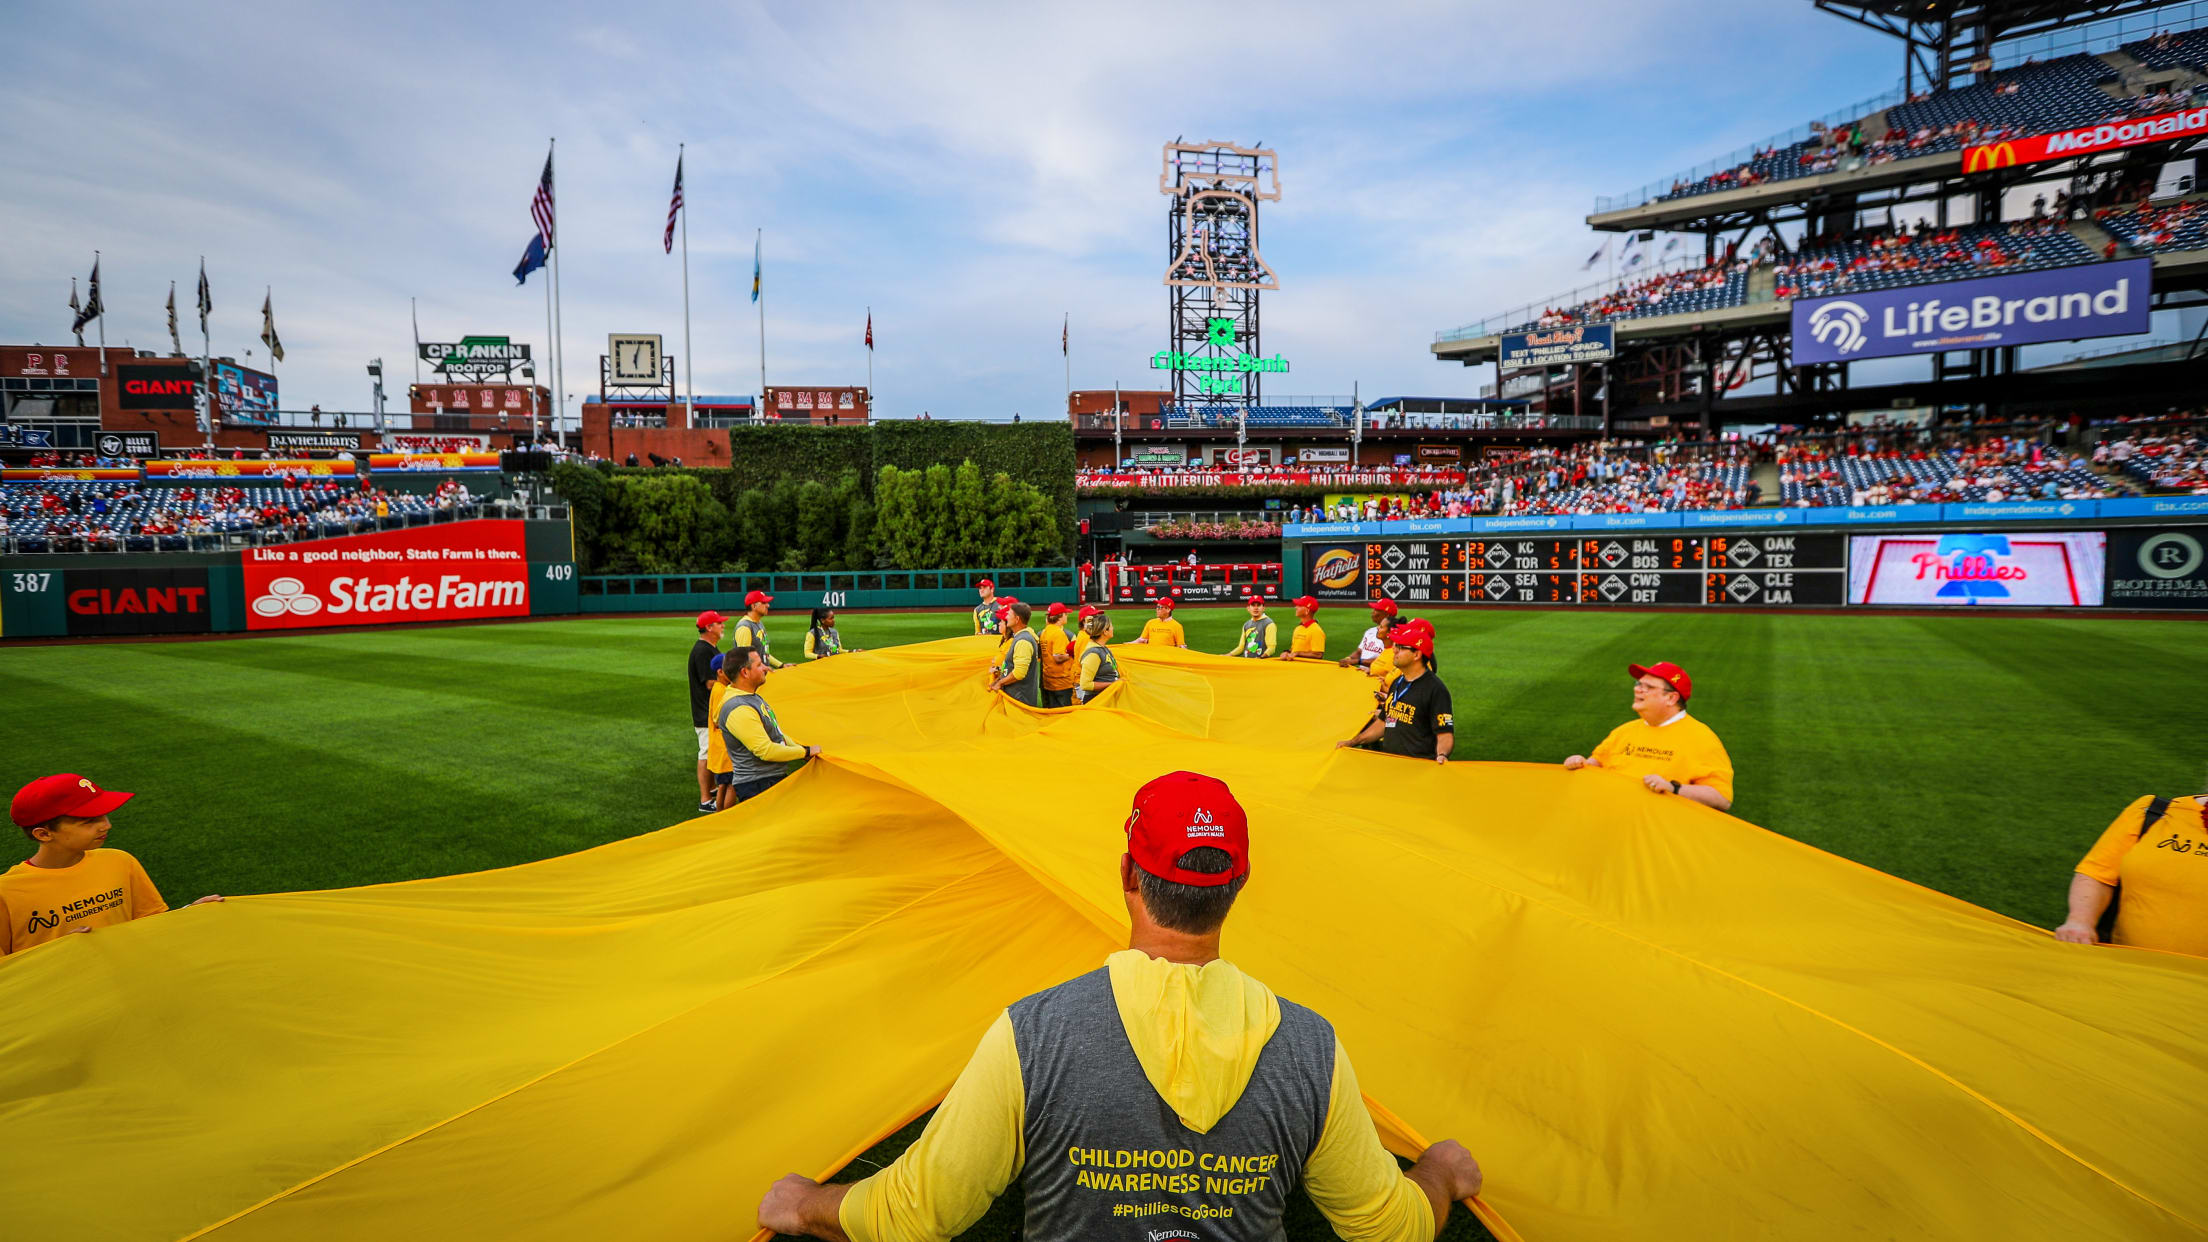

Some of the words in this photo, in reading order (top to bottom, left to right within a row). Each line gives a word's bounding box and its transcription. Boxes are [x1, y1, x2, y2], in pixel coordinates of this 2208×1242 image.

[1884, 278, 2128, 338] LifeBrand
[1553, 327, 1584, 344] Help?
[427, 344, 453, 358] CP
[456, 344, 522, 358] RANKIN
[1511, 349, 1529, 358] TEXT
[1154, 350, 1235, 371] Citizens
[1238, 353, 1288, 373] Bank
[1503, 358, 1524, 368] ISSUE
[1533, 353, 1572, 364] LOCATION
[1574, 351, 1584, 359] TO
[446, 363, 505, 373] ROOFTOP
[125, 379, 195, 395] GIANT
[1200, 375, 1242, 394] Park
[430, 390, 438, 401] 1
[453, 390, 468, 401] 14
[480, 390, 494, 401] 15
[505, 390, 521, 401] 20
[778, 391, 793, 404] 32
[797, 391, 813, 404] 34
[818, 391, 832, 404] 36
[125, 437, 151, 445] ALLEY
[126, 445, 153, 454] STORE
[1848, 509, 1896, 519] ibx.com
[1963, 504, 2056, 516] Independence
[1485, 518, 1545, 529] Independence
[1606, 516, 1646, 526] ibx.com
[1699, 511, 1772, 524] Independence
[1301, 524, 1351, 534] Independence
[1409, 522, 1442, 531] ibx.com
[1368, 544, 1382, 556] 59
[1410, 543, 1430, 556] MIL
[1441, 543, 1449, 556] 2
[1469, 542, 1485, 555] 23
[1518, 541, 1534, 554] KC
[1554, 541, 1560, 553] 1
[1584, 540, 1599, 554] 15
[1632, 540, 1659, 553] BAL
[1711, 538, 1727, 552] 16
[1764, 536, 1796, 551] OAK
[253, 549, 285, 561] Like
[289, 552, 299, 561] a
[303, 549, 338, 563] good
[341, 548, 403, 563] neighbor,
[406, 548, 439, 560] State
[442, 548, 473, 560] Farm
[475, 548, 485, 559] is
[487, 548, 521, 559] there.
[1457, 550, 1466, 562] 6
[1569, 548, 1577, 560] F
[1693, 547, 1704, 561] 2
[1710, 554, 1727, 567] 17
[1764, 553, 1794, 568] TEX
[2158, 547, 2183, 564] R
[1313, 553, 1360, 584] Hatfield
[1368, 558, 1382, 570] 85
[1409, 558, 1430, 570] NYY
[1441, 558, 1449, 570] 2
[1469, 557, 1485, 570] 34
[1514, 557, 1539, 569] TOR
[1550, 556, 1559, 569] 5
[1581, 557, 1599, 568] 41
[1632, 555, 1660, 569] BOS
[1672, 555, 1683, 568] 2
[1911, 552, 2027, 581] Phillies
[545, 564, 572, 581] 409
[1469, 574, 1485, 586] 30
[1515, 573, 1539, 586] SEA
[1550, 575, 1559, 585] 4
[13, 573, 51, 592] 387
[1368, 574, 1382, 586] 23
[1408, 574, 1431, 586] NYM
[1441, 575, 1449, 585] 4
[1458, 580, 1465, 592] F
[1569, 581, 1578, 592] 7
[1581, 573, 1598, 586] 54
[1630, 573, 1661, 587] CWS
[1707, 573, 1726, 587] 27
[1764, 573, 1794, 587] CLE
[67, 587, 205, 615] GIANT
[822, 591, 846, 607] 401
[1370, 588, 1382, 599] 18
[1410, 588, 1430, 600] MIN
[1441, 588, 1449, 600] 8
[1518, 589, 1534, 601] TB
[1551, 589, 1559, 601] 3
[1581, 589, 1598, 602] 29
[1632, 589, 1658, 603] DET
[1707, 589, 1726, 603] 31
[1763, 589, 1793, 603] LAA
[62, 887, 123, 914] NEMOURS
[65, 903, 109, 923] CHILDREN'S
[1068, 1146, 1195, 1169] CHILDHOOD
[1199, 1153, 1279, 1174] CANCER
[1076, 1169, 1200, 1194] AWARENESS
[1205, 1176, 1271, 1195] NIGHT
[1112, 1201, 1234, 1221] #PhilliesGoGold
